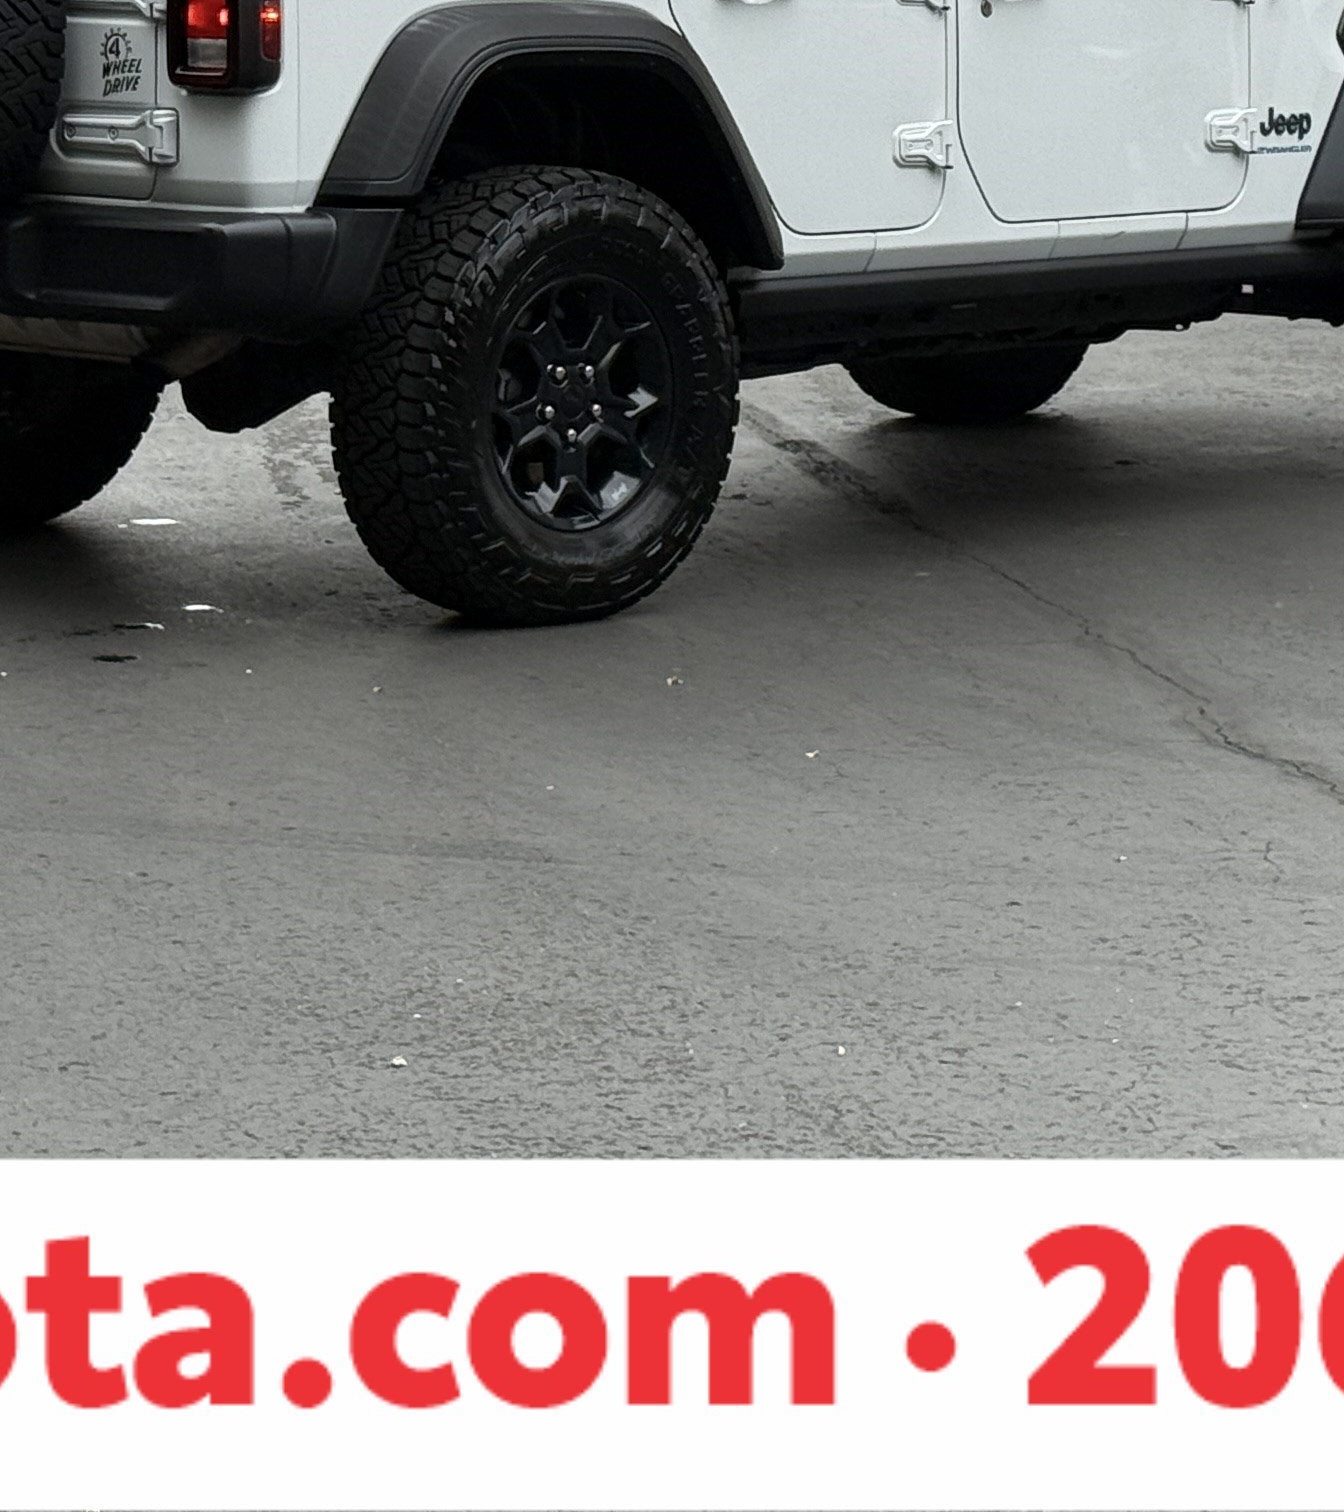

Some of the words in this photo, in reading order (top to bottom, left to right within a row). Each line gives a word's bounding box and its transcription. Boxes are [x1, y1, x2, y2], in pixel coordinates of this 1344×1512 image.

[108, 37, 121, 59] 4
[102, 58, 142, 79] WHEEL
[102, 76, 141, 97] DRIVE
[1259, 106, 1312, 141] Jeep
